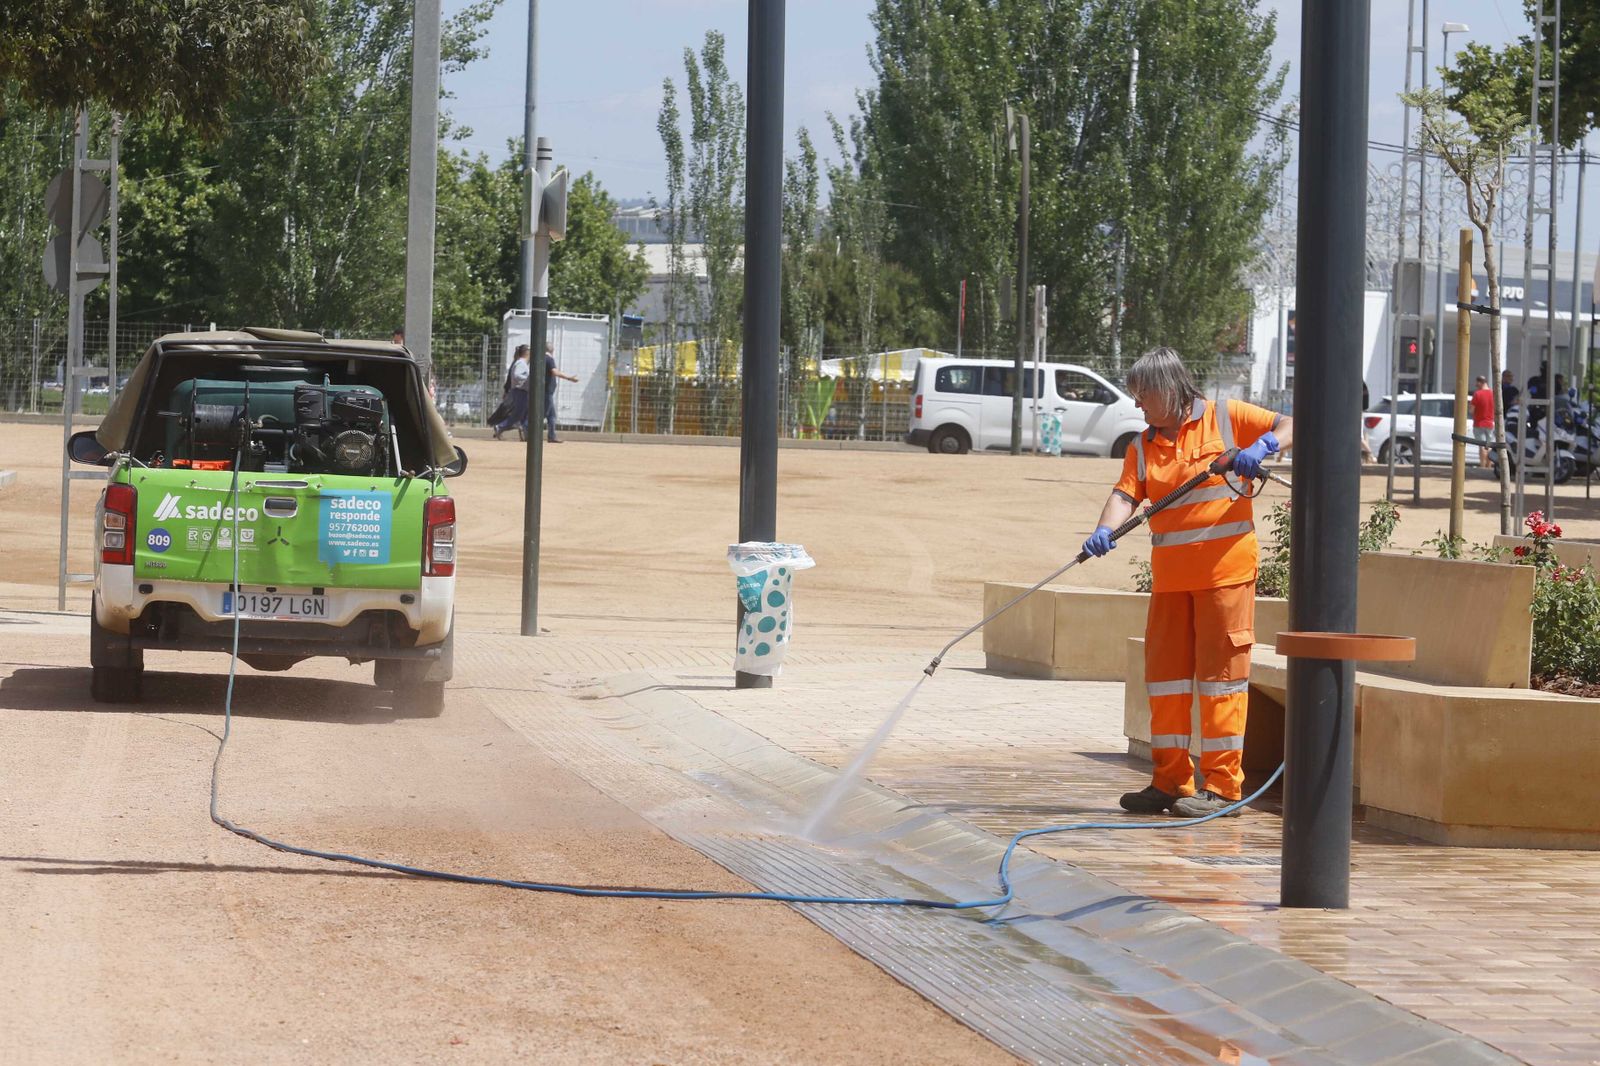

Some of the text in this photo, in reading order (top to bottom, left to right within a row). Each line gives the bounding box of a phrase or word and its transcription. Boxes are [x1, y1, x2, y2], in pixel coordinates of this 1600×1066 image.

[330, 496, 382, 510] sadeco
[185, 501, 259, 522] sadeco
[330, 510, 381, 522] responde
[329, 523, 380, 533] 957762000
[147, 534, 171, 547] 809
[237, 595, 325, 615] 0197 LGN
